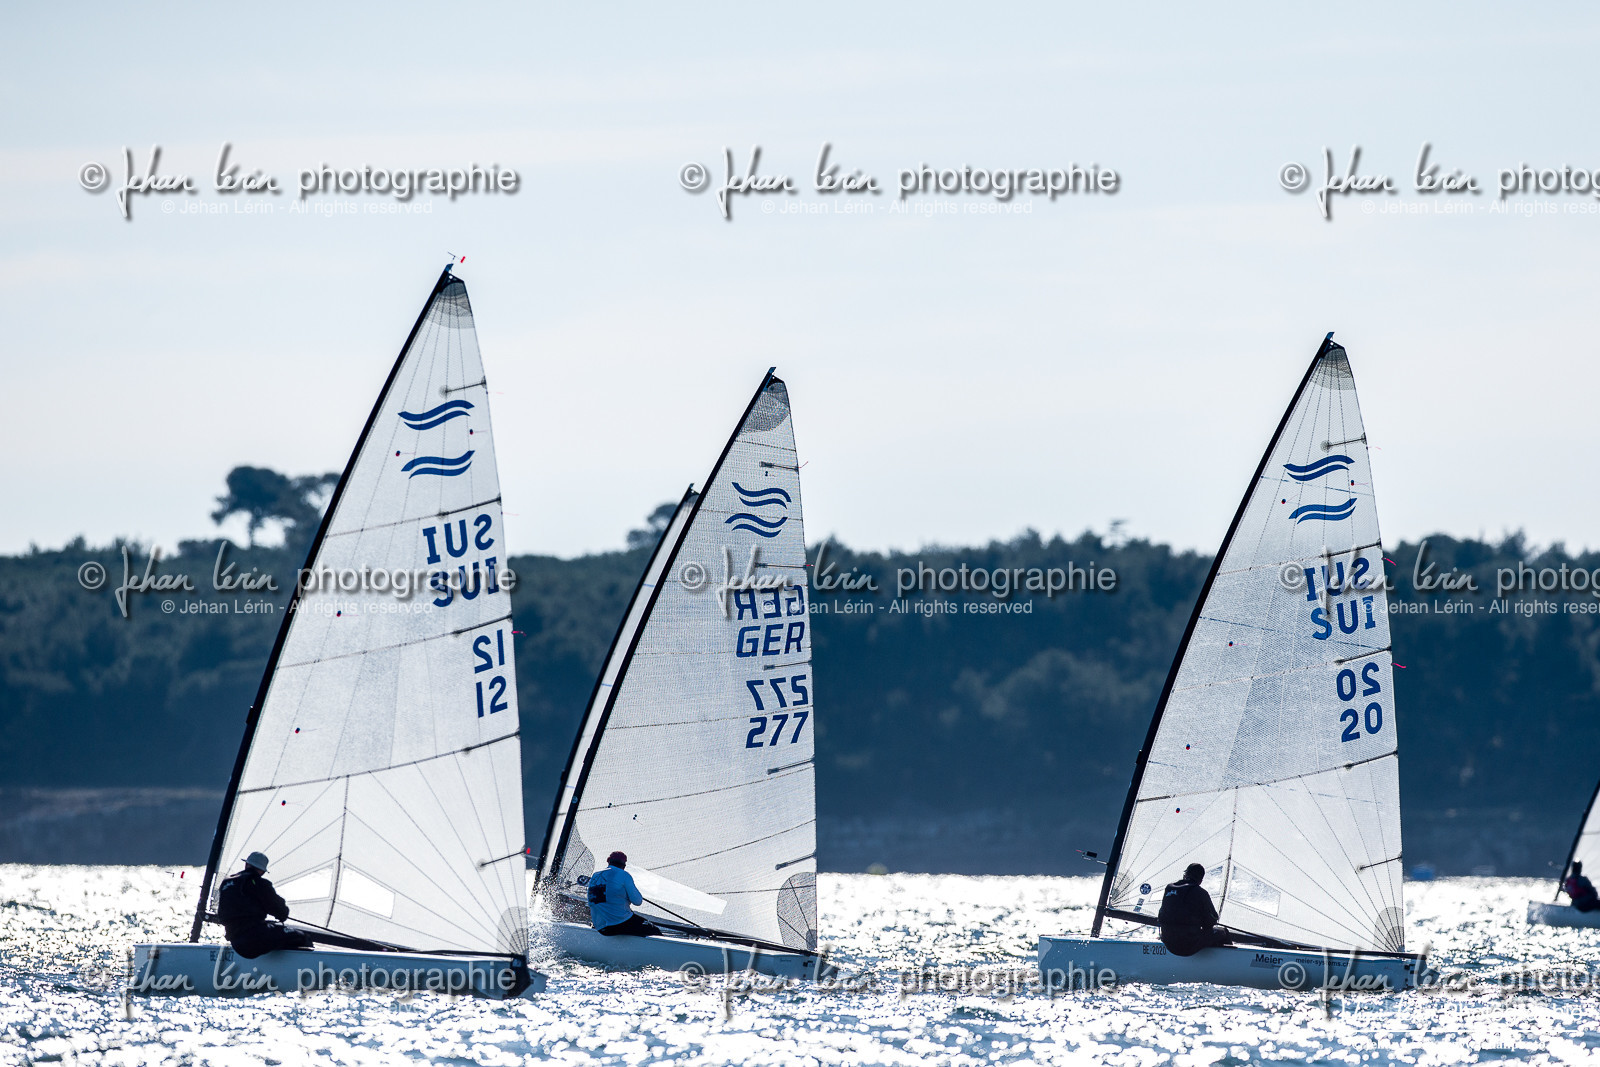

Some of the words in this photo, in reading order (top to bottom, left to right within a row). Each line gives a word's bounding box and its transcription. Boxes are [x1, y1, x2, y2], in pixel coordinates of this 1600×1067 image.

[430, 556, 499, 607] SUI
[1310, 595, 1376, 640] SUI
[736, 621, 805, 658] GER
[476, 675, 508, 718] 12
[745, 711, 809, 748] 277
[1340, 702, 1382, 743] 20
[1255, 953, 1283, 965] Meier
[1295, 956, 1351, 968] meier-sysems.ch
